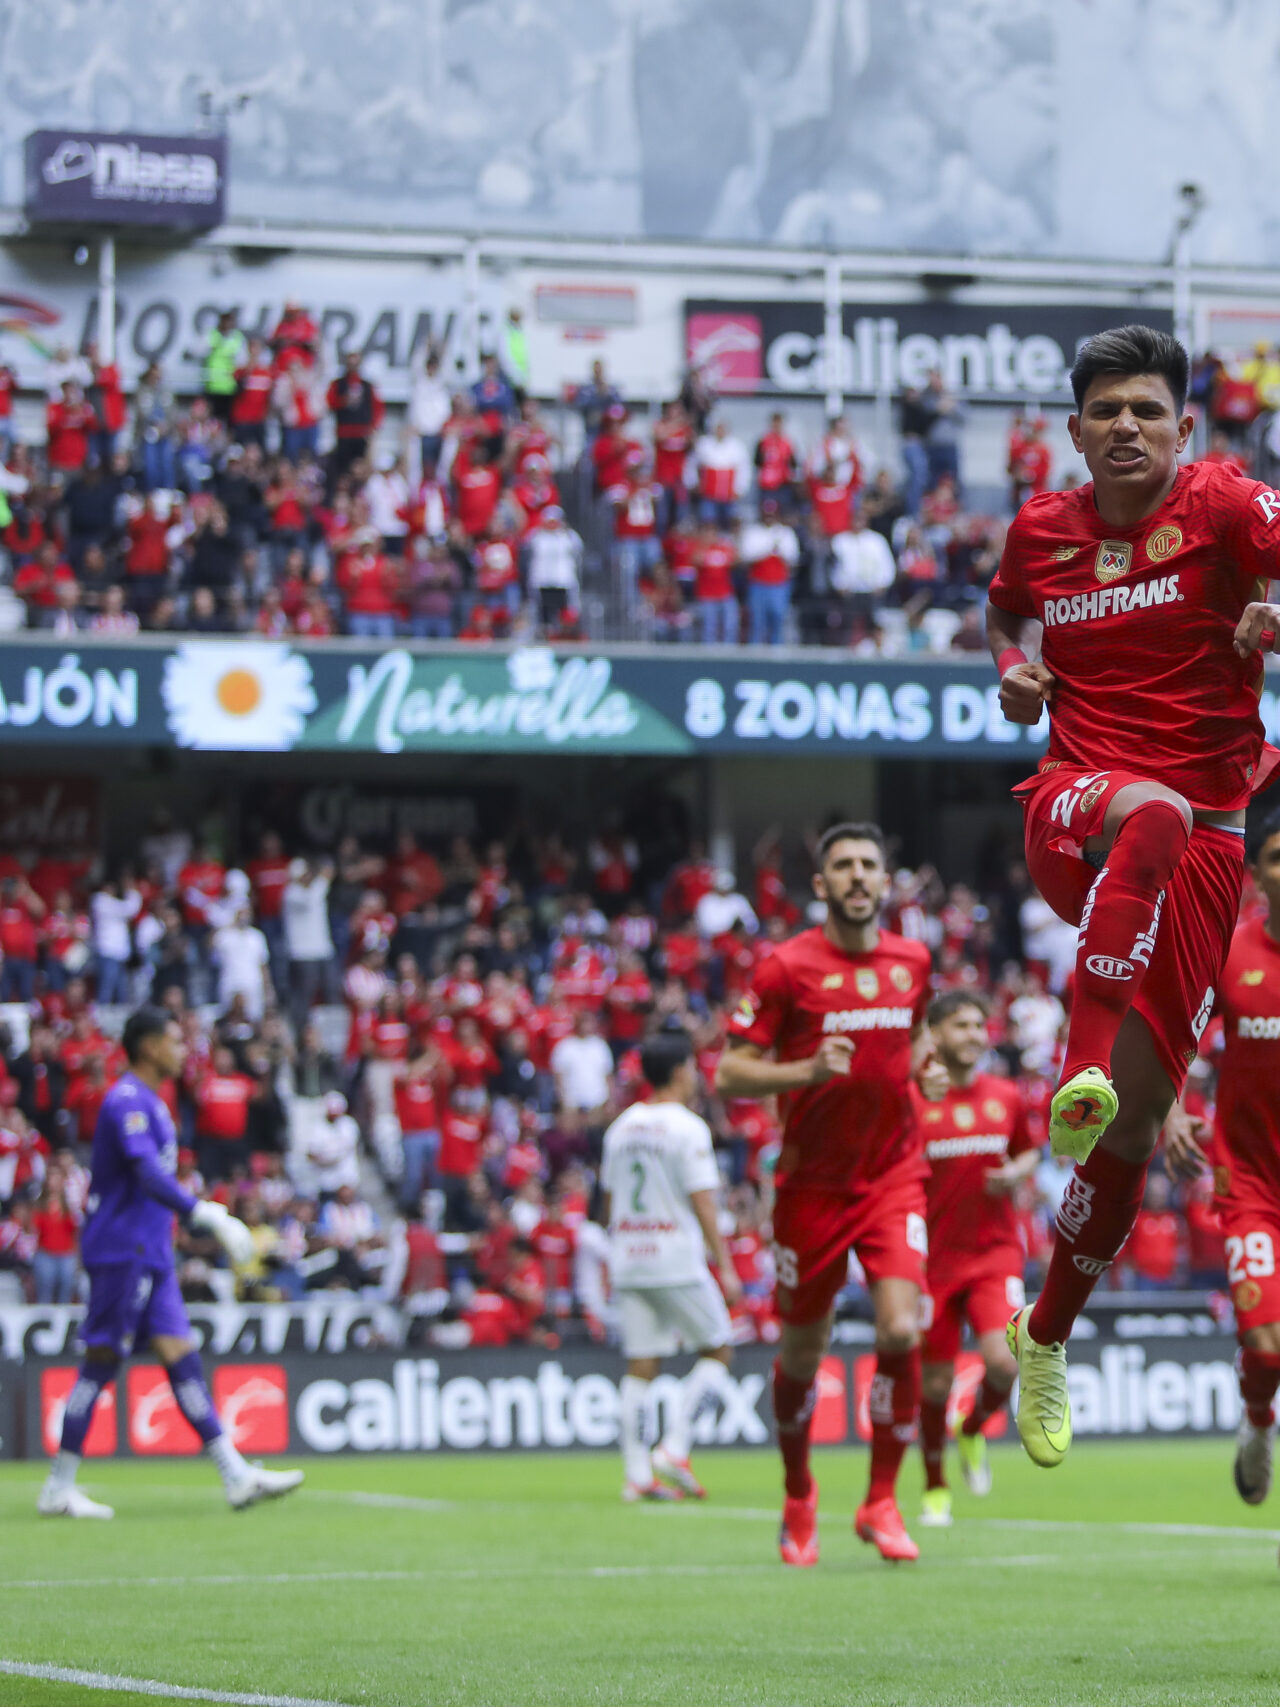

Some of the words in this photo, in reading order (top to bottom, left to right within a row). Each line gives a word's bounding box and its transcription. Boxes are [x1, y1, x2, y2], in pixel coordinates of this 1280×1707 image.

[1043, 574, 1180, 627] ROSHFRANS
[0, 652, 139, 728] JÓN
[685, 678, 726, 739] 8
[733, 679, 932, 743] ZONAS
[1224, 1231, 1276, 1283] 29
[296, 1358, 769, 1452] calientemx
